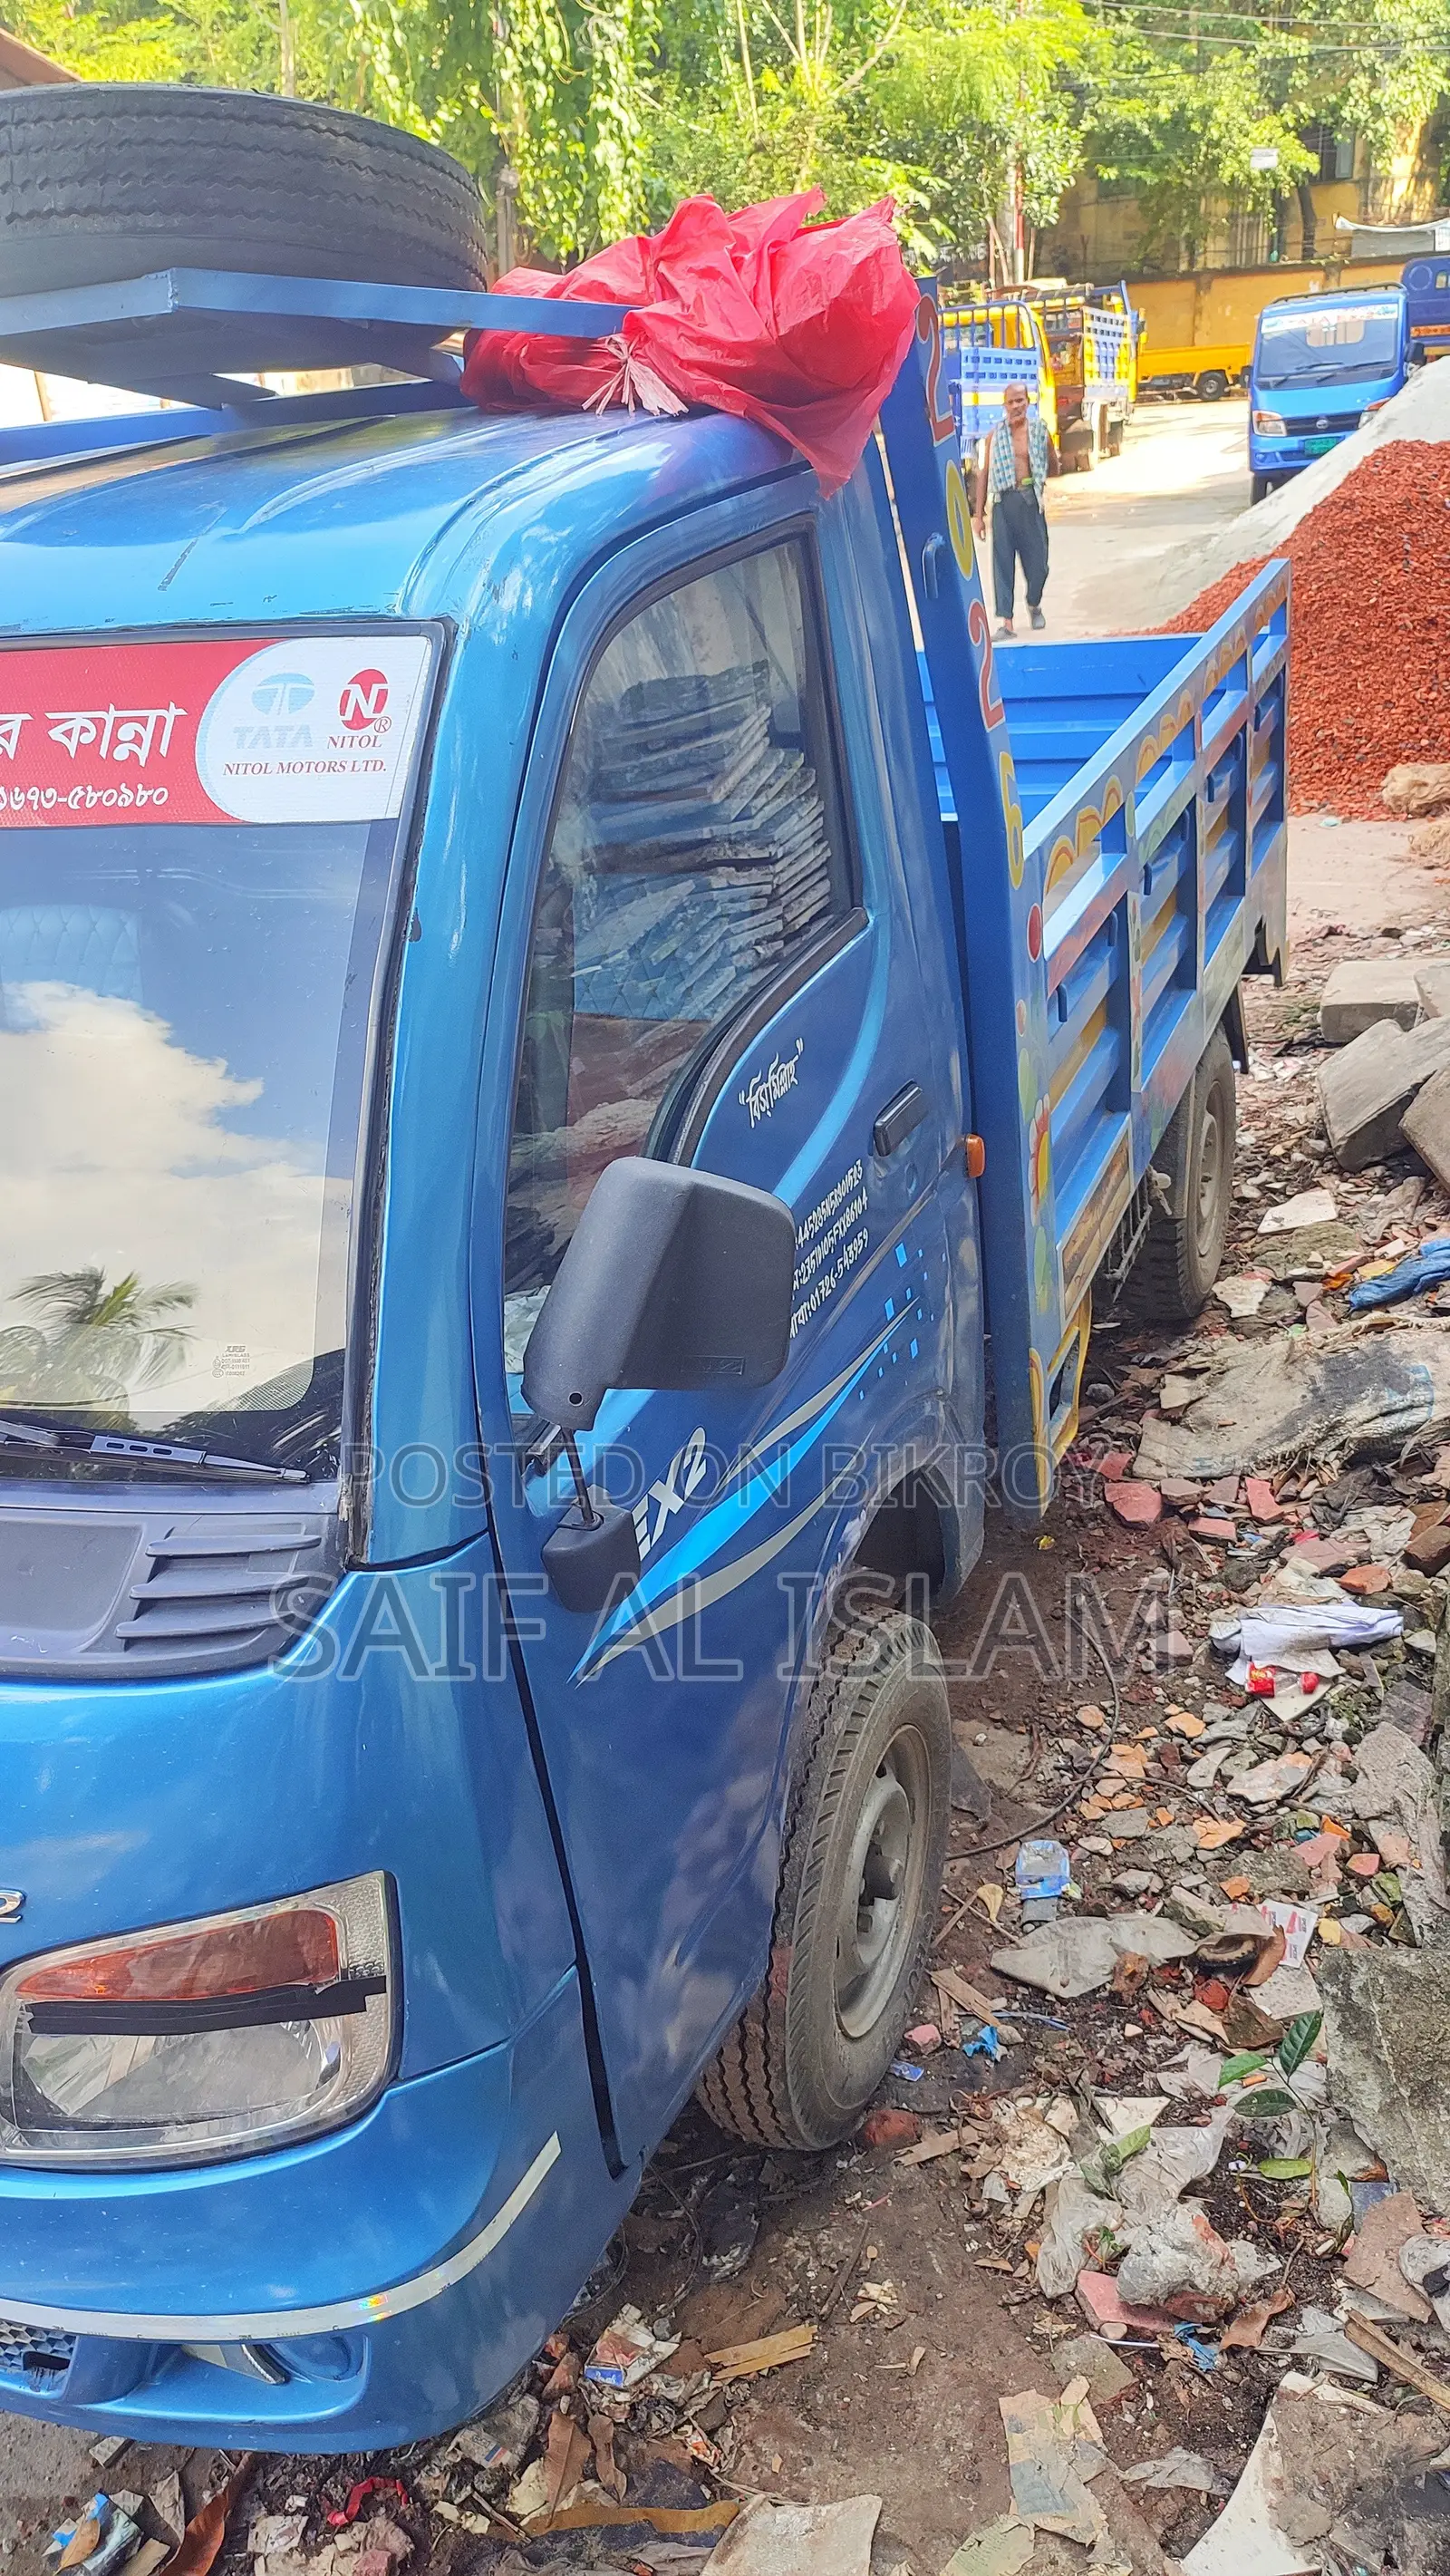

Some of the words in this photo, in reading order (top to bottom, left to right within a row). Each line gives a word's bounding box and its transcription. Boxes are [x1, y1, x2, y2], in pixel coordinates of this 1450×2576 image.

[44, 701, 188, 768] কান্না
[233, 724, 314, 751] TATA
[327, 734, 382, 750] NITOL
[223, 762, 272, 777] NITOL
[276, 760, 347, 776] MOTORS
[350, 758, 387, 773] LTD.
